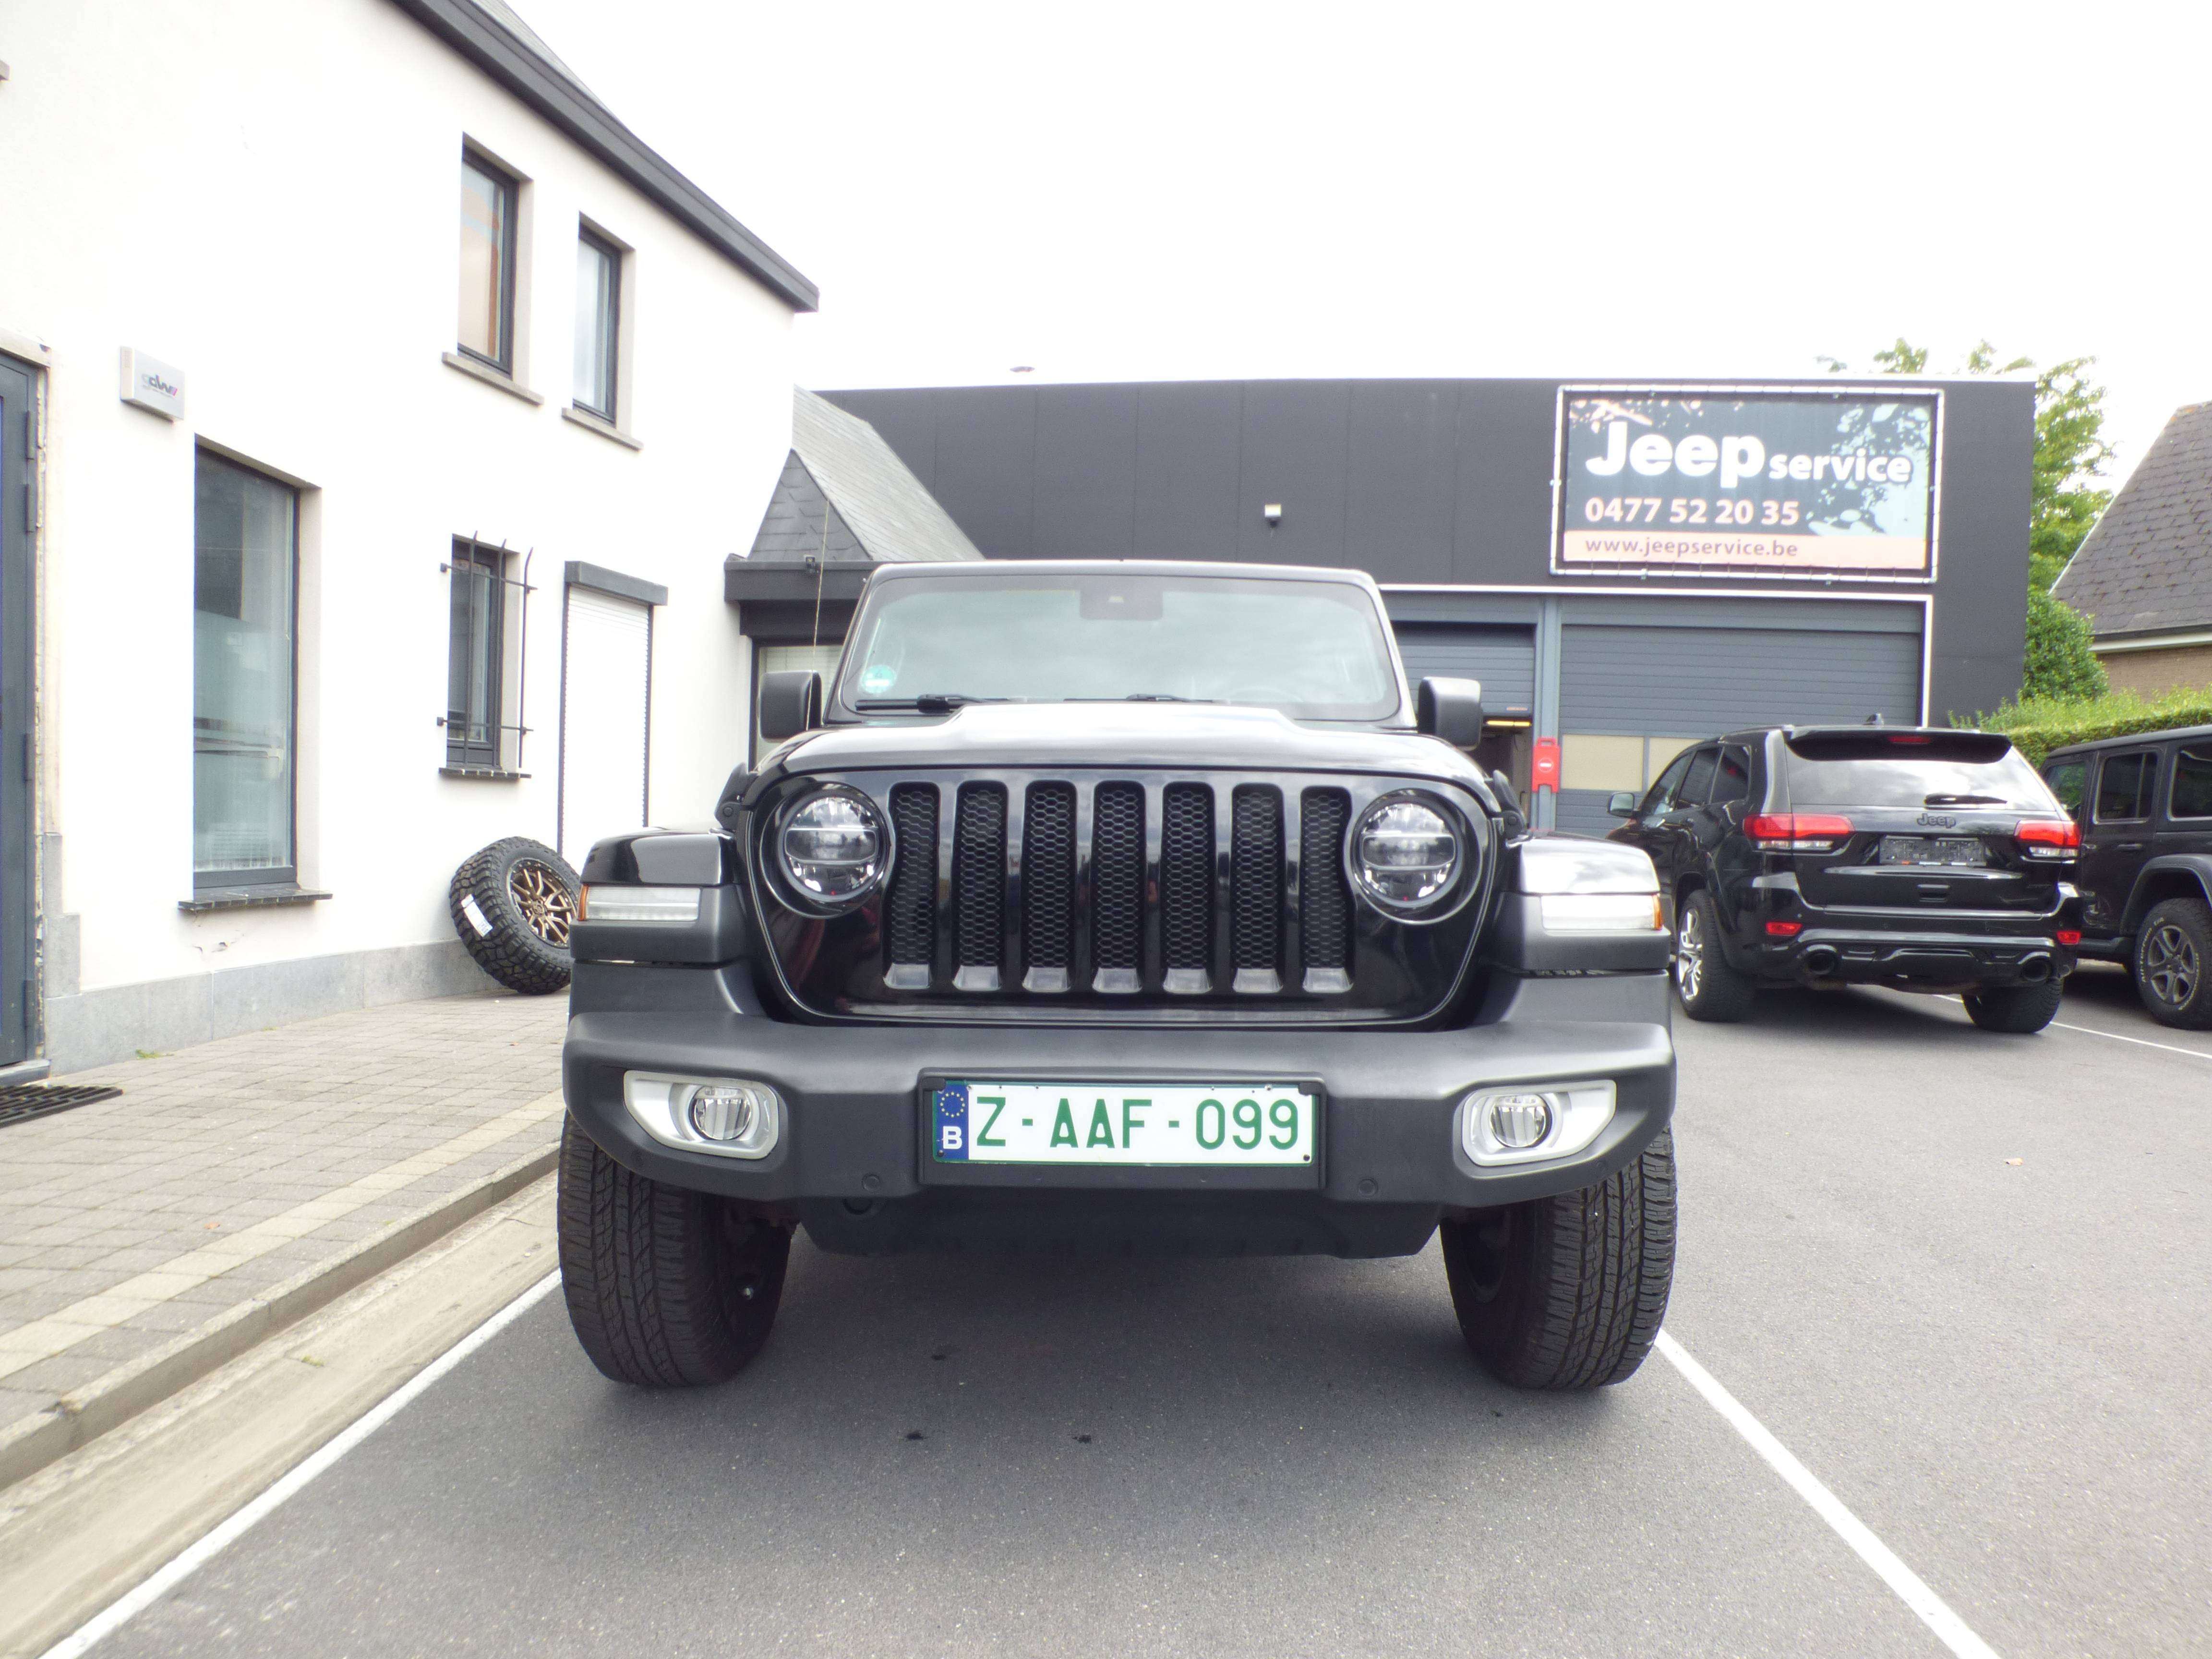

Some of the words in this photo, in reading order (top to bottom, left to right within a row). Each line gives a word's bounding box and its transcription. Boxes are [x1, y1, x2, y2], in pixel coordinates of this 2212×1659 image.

[1585, 421, 1765, 488] Jeep
[1769, 449, 1912, 482] service
[1585, 497, 1662, 523] 0477
[1670, 498, 1707, 524] 52
[1715, 499, 1754, 525] 20
[1761, 500, 1800, 526] 35
[1586, 537, 1799, 558] www.jeepservice.be
[1917, 813, 1957, 829] Jeep
[976, 1096, 1298, 1151] Z-AAF-099
[942, 1126, 962, 1149] B
